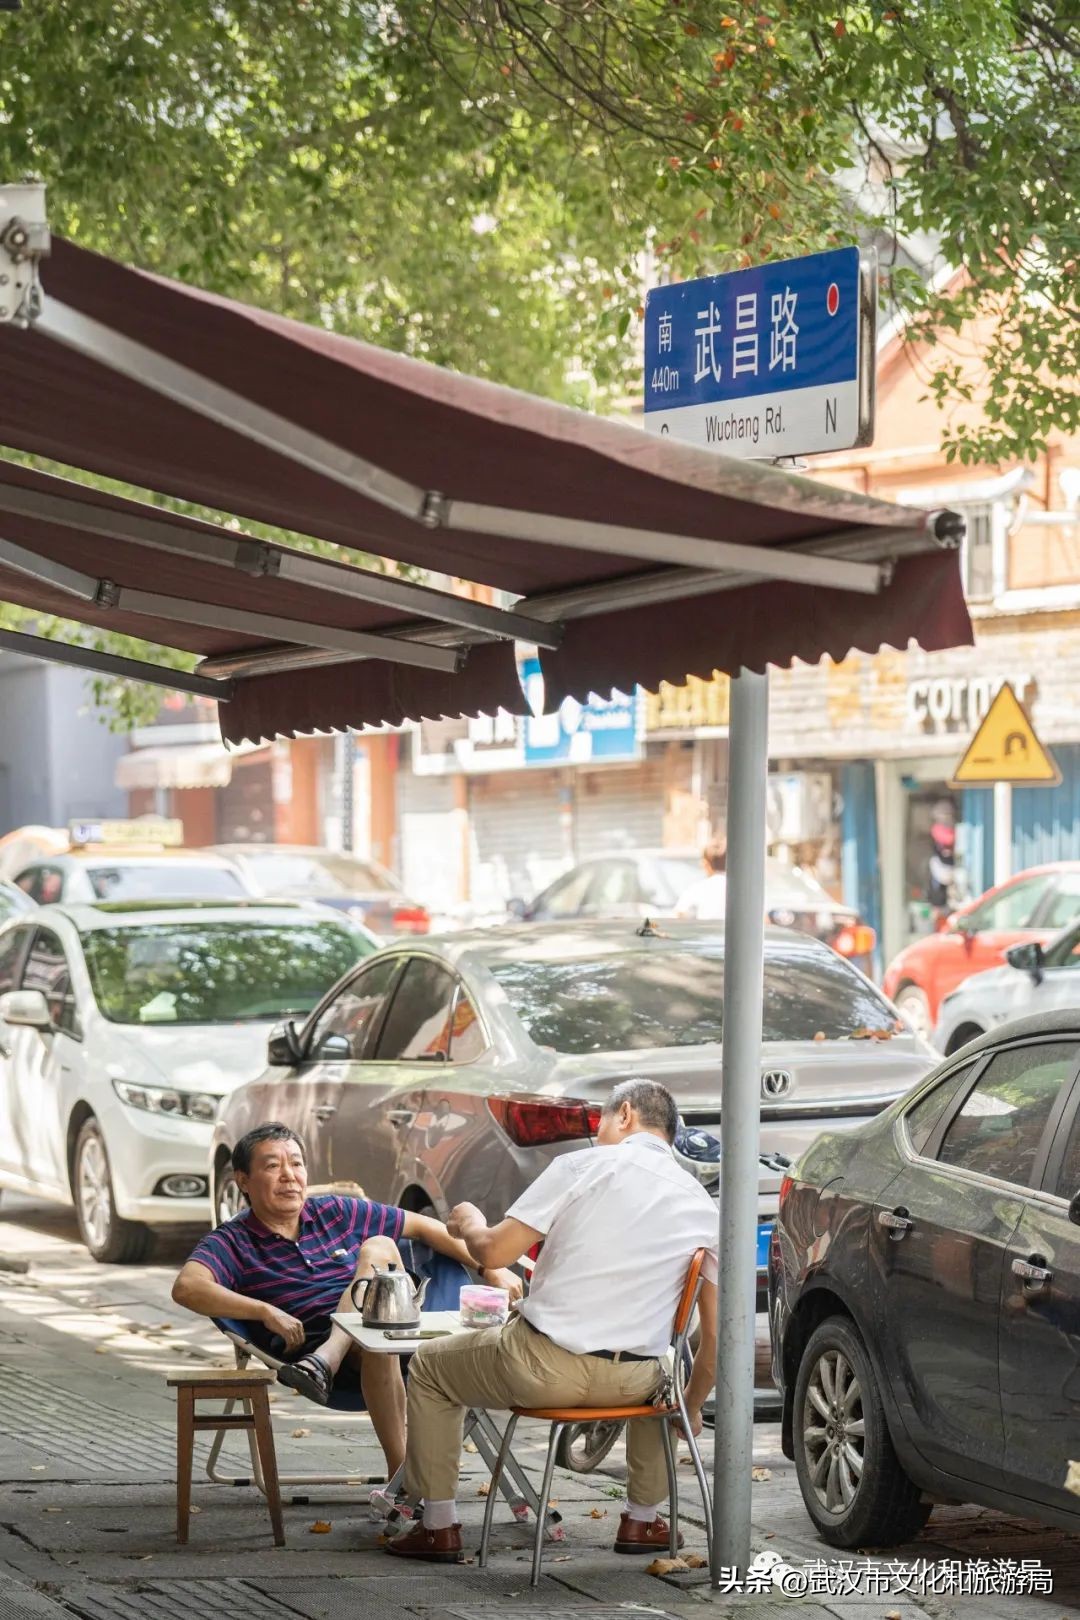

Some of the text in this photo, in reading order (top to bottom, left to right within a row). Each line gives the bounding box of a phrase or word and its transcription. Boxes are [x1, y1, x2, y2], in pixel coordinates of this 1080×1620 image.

[658, 311, 673, 354] 南
[694, 286, 799, 383] 武昌路
[651, 365, 680, 393] 440m
[705, 406, 785, 443] Wuchang Rd.
[825, 398, 837, 434] N
